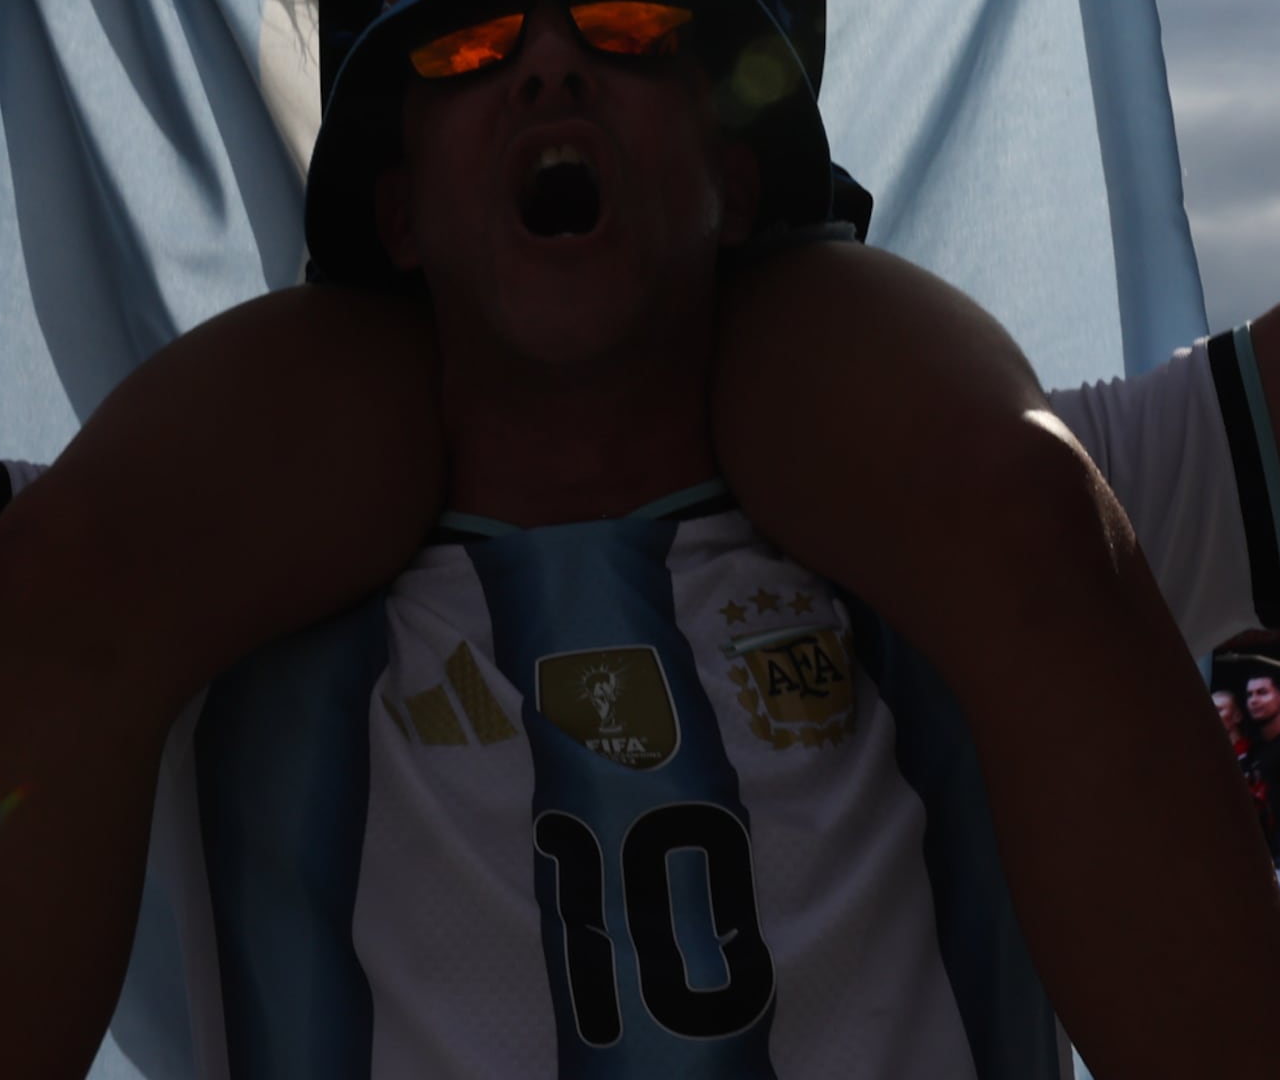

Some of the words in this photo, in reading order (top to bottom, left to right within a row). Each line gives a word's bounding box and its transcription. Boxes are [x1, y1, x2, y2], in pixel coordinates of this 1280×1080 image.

[762, 635, 844, 699] AFA
[585, 737, 646, 754] FIFA
[534, 801, 775, 1048] 10
